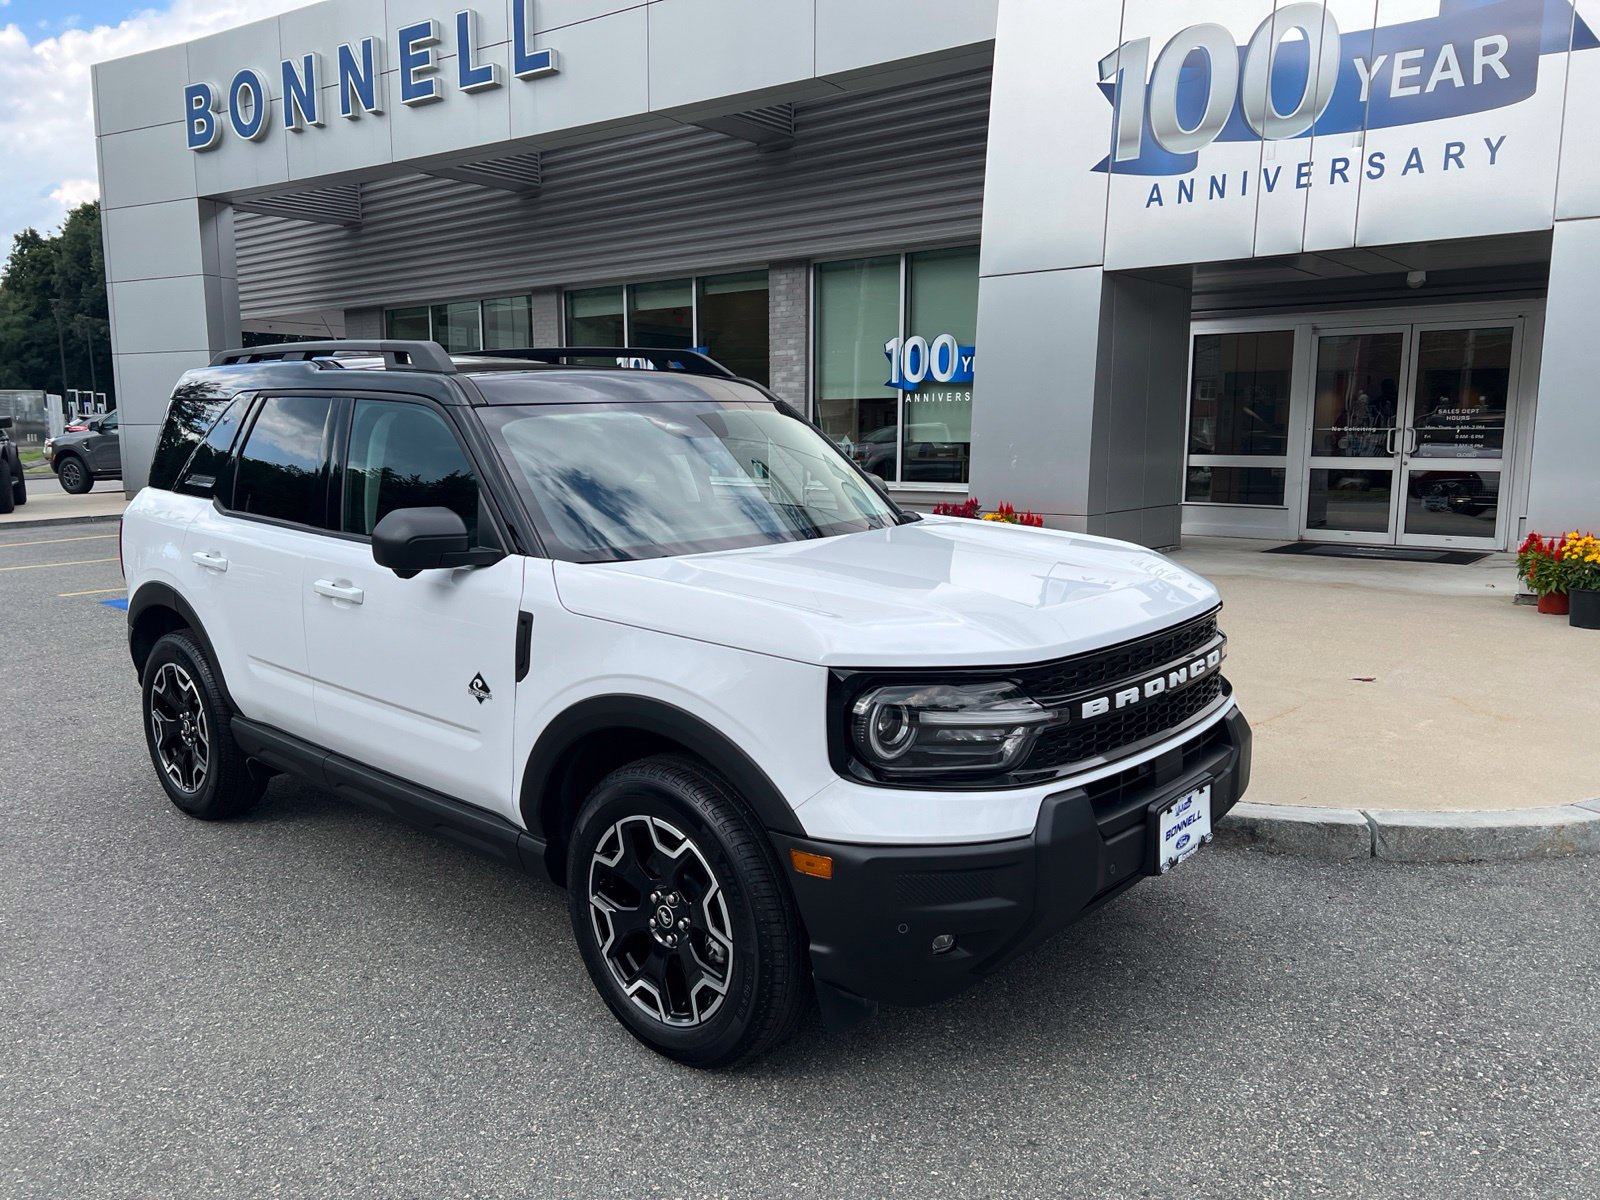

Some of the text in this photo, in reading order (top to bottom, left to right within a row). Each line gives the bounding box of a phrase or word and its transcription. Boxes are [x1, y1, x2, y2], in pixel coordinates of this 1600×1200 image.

[184, 0, 558, 152] BONNELL
[1098, 1, 1511, 162] 100 YEAR
[1145, 135, 1507, 208] ANNIVERSARY
[885, 334, 959, 383] 100
[905, 392, 971, 403] ANNIVERS
[1081, 649, 1220, 719] BRONCO
[1165, 810, 1202, 842] BONNELL
